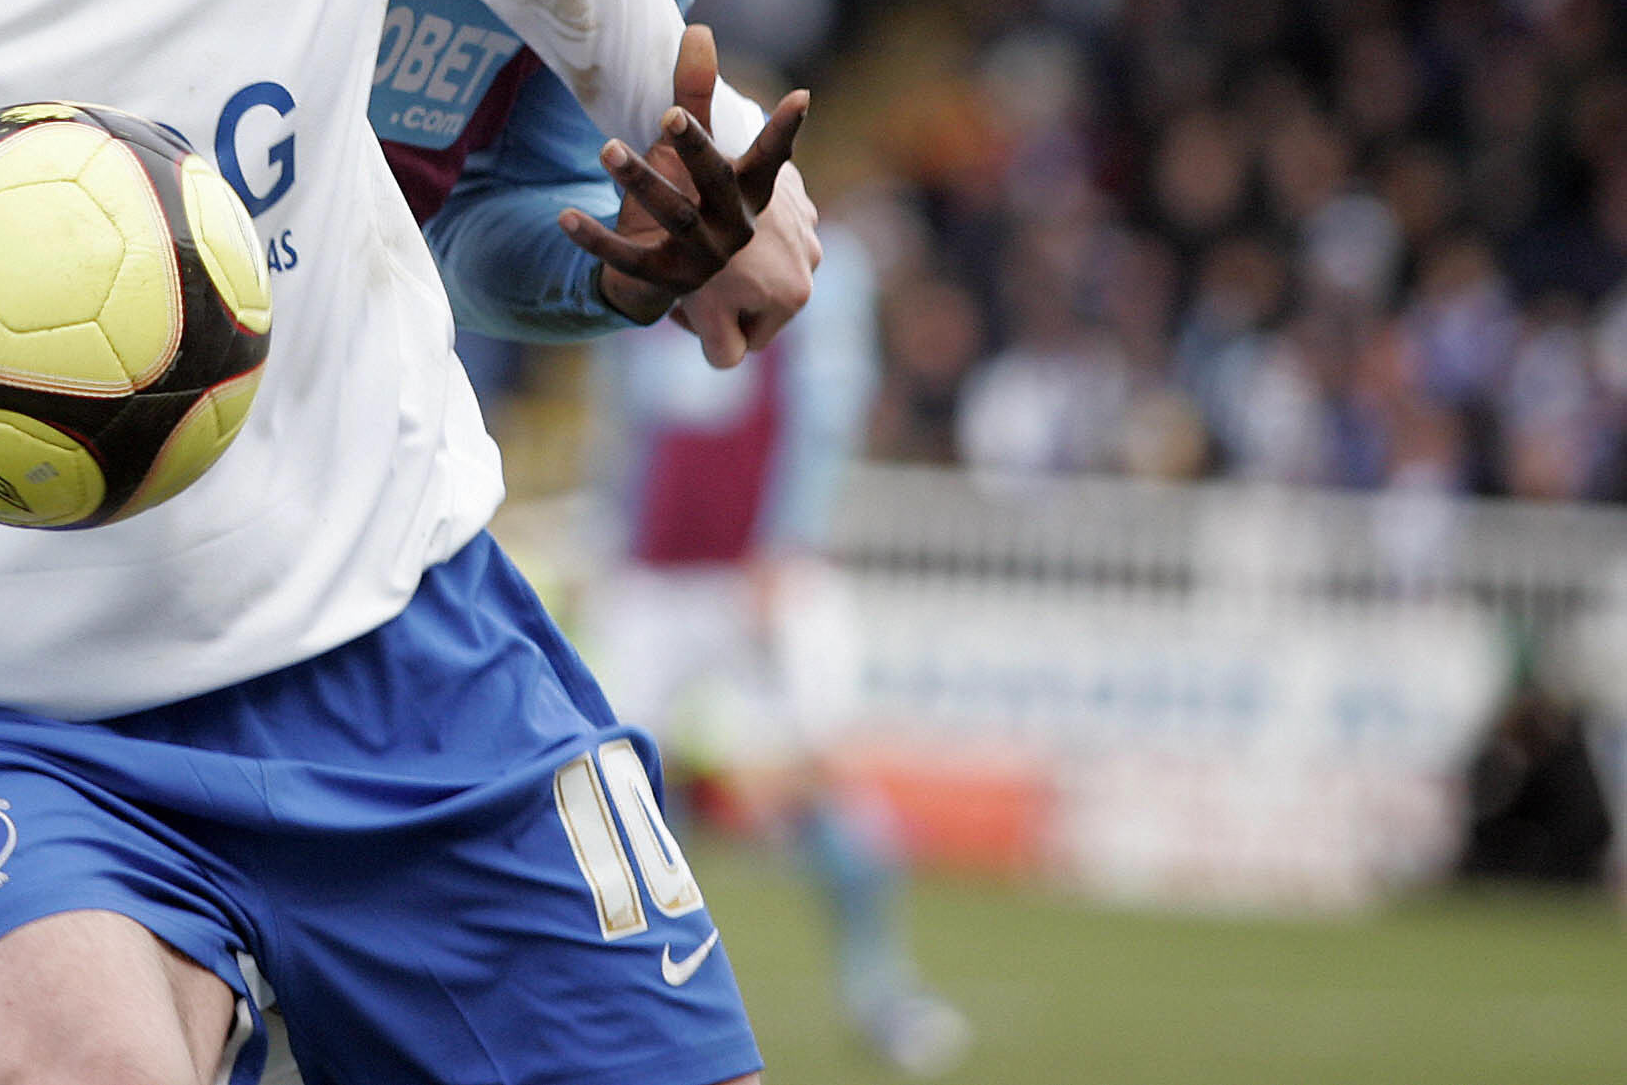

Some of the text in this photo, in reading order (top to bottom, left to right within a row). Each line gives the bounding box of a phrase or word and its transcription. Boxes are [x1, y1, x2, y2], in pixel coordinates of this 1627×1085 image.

[155, 81, 296, 219] G
[390, 105, 465, 134] .com
[553, 738, 705, 941] 10
